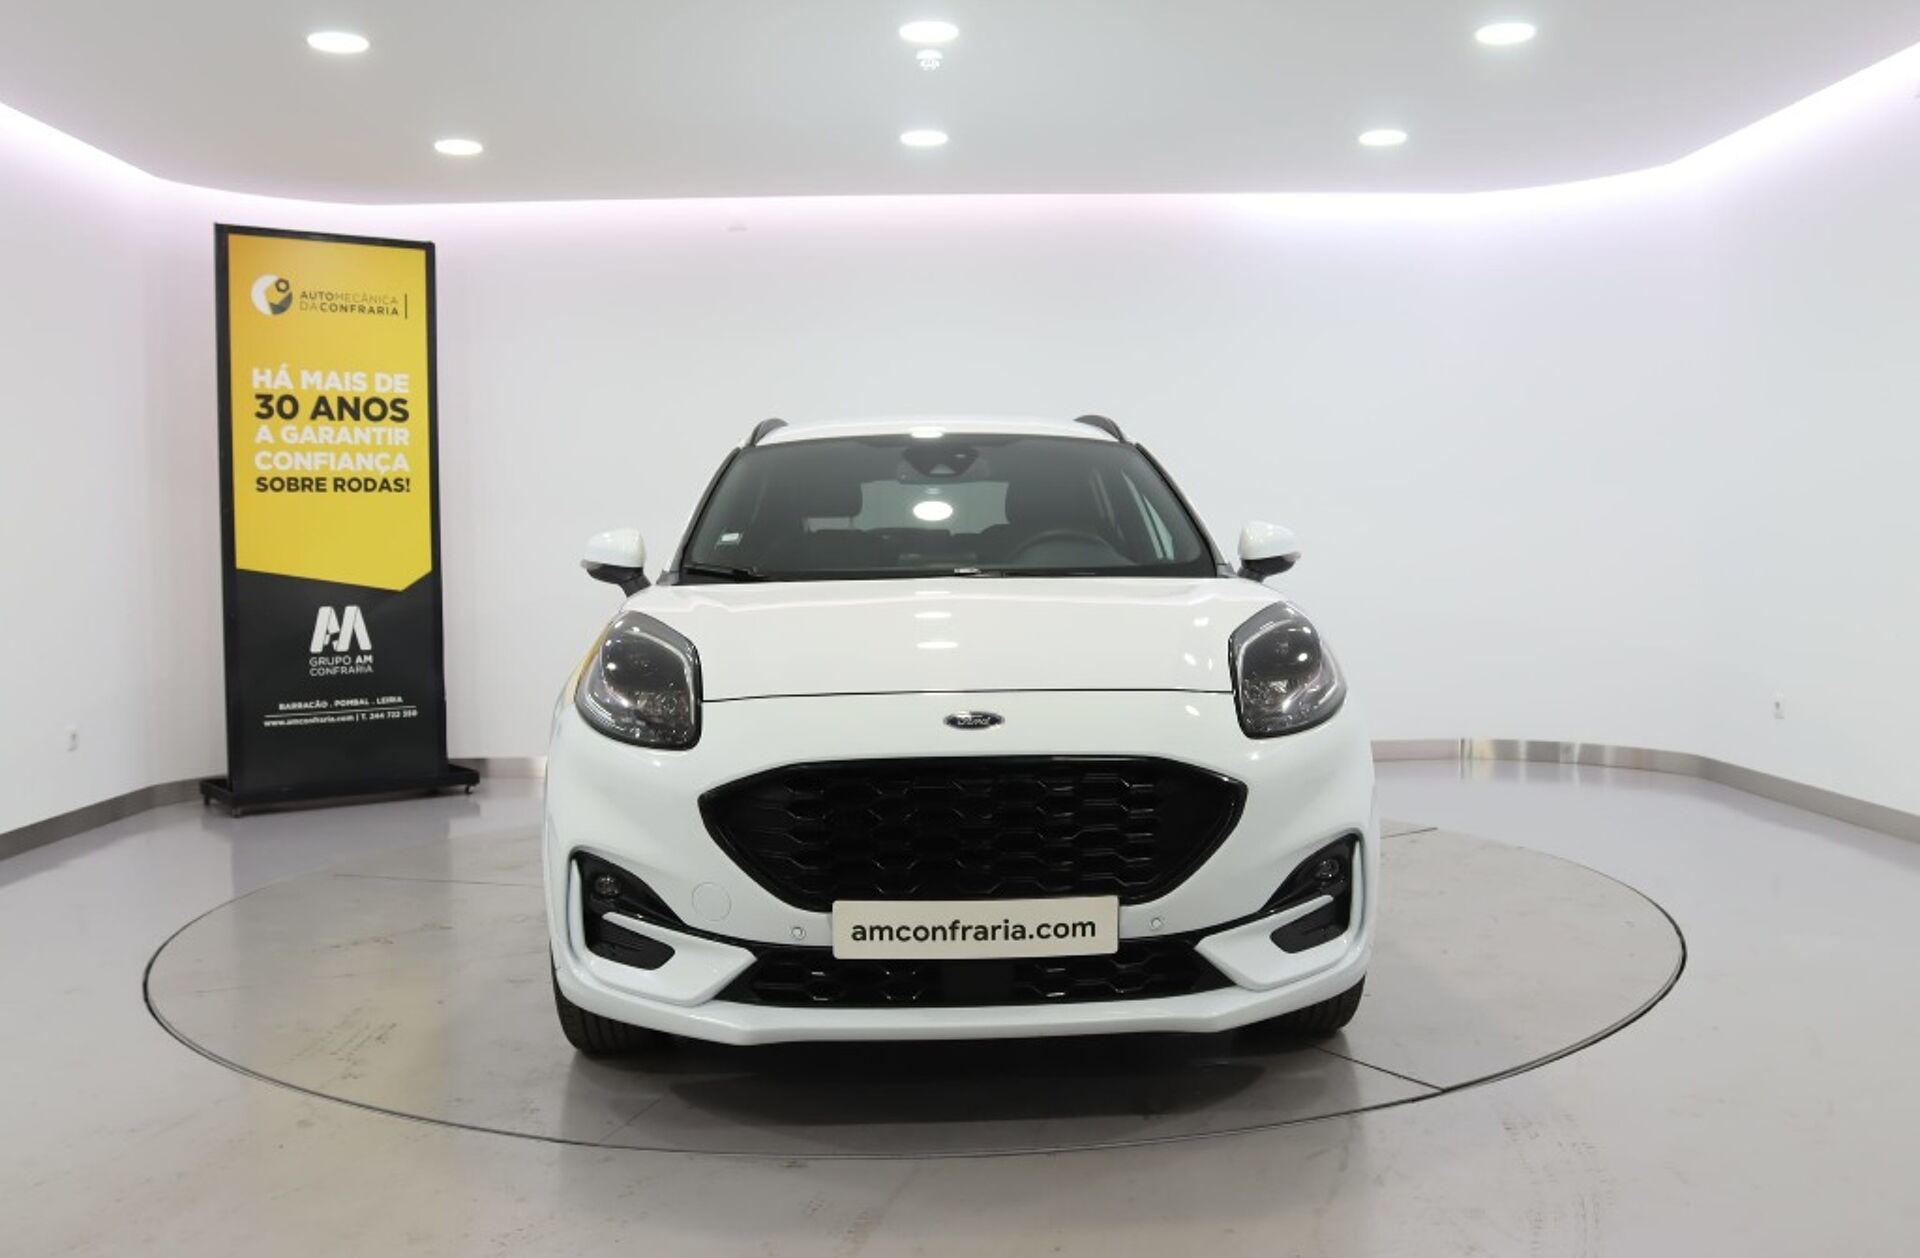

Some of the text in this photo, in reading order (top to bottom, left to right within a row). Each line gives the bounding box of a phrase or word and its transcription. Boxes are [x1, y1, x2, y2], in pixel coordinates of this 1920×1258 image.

[252, 363, 410, 394] HÁ MAIS DE
[254, 393, 410, 424] 30 ANOS
[255, 424, 410, 446] A GARANTIR
[254, 450, 410, 475] CONFIANÇA
[256, 476, 411, 493] SOBRE RODAS!
[309, 654, 374, 667] GRUPO AM
[309, 664, 374, 677] CONFRARIA
[334, 697, 369, 708] POMBAL
[376, 695, 404, 705] LEIRIA
[263, 715, 355, 727] www.amconfraria.com
[957, 715, 991, 726] Ford
[851, 919, 1097, 942] amconfraria.com
